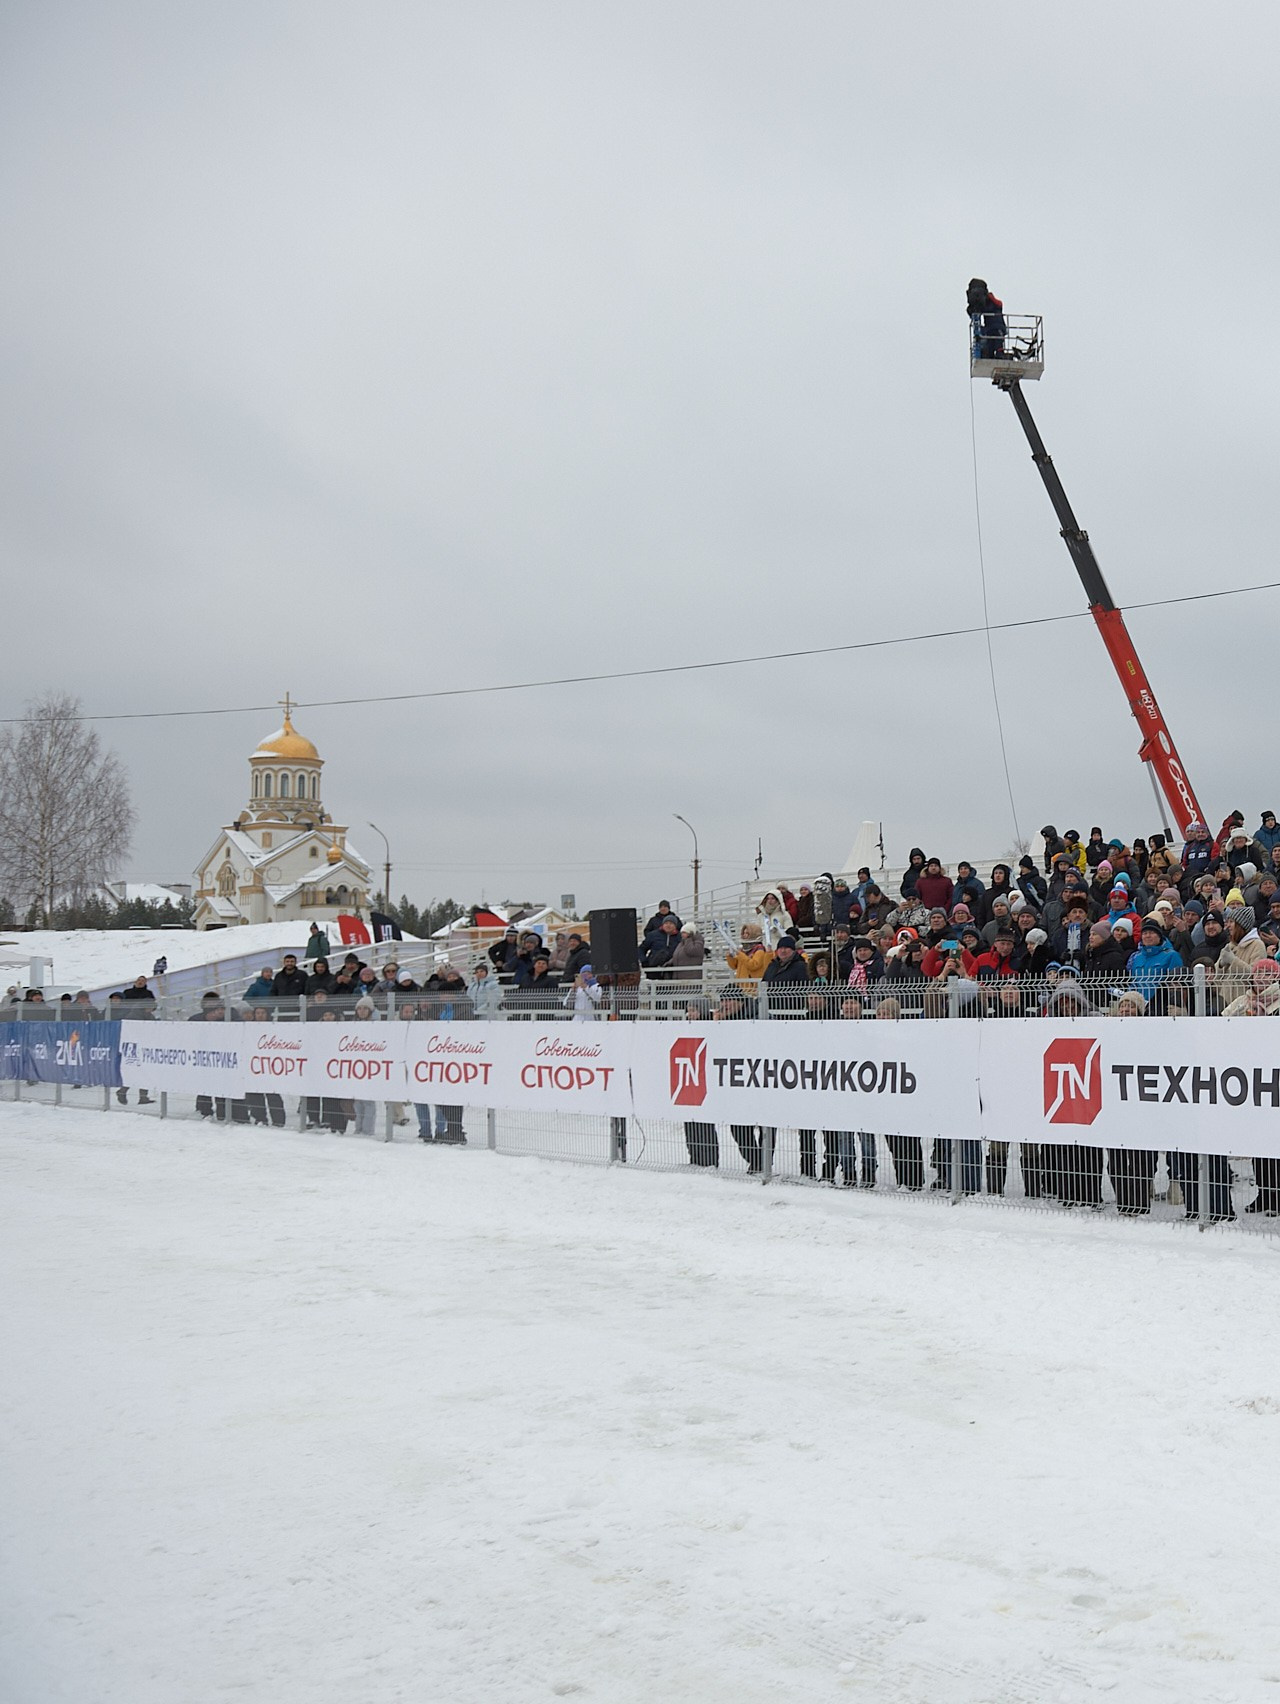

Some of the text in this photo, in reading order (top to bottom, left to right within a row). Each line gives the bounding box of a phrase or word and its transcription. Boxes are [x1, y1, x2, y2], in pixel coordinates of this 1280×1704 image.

[257, 1034, 303, 1050] Советский
[338, 1035, 388, 1052] Советский
[427, 1035, 487, 1054] Советский
[534, 1036, 603, 1057] Советский
[142, 1048, 187, 1066] УРАЛЭНЕРГО
[192, 1050, 238, 1069] ЭЛЕКТРИКА
[250, 1055, 308, 1077] СПОРТ
[326, 1058, 394, 1081] СПОРТ
[414, 1060, 493, 1085] СПОРТ
[521, 1064, 615, 1092] СПОРТ
[712, 1057, 917, 1094] ТЕХНОНИКОЛЬ
